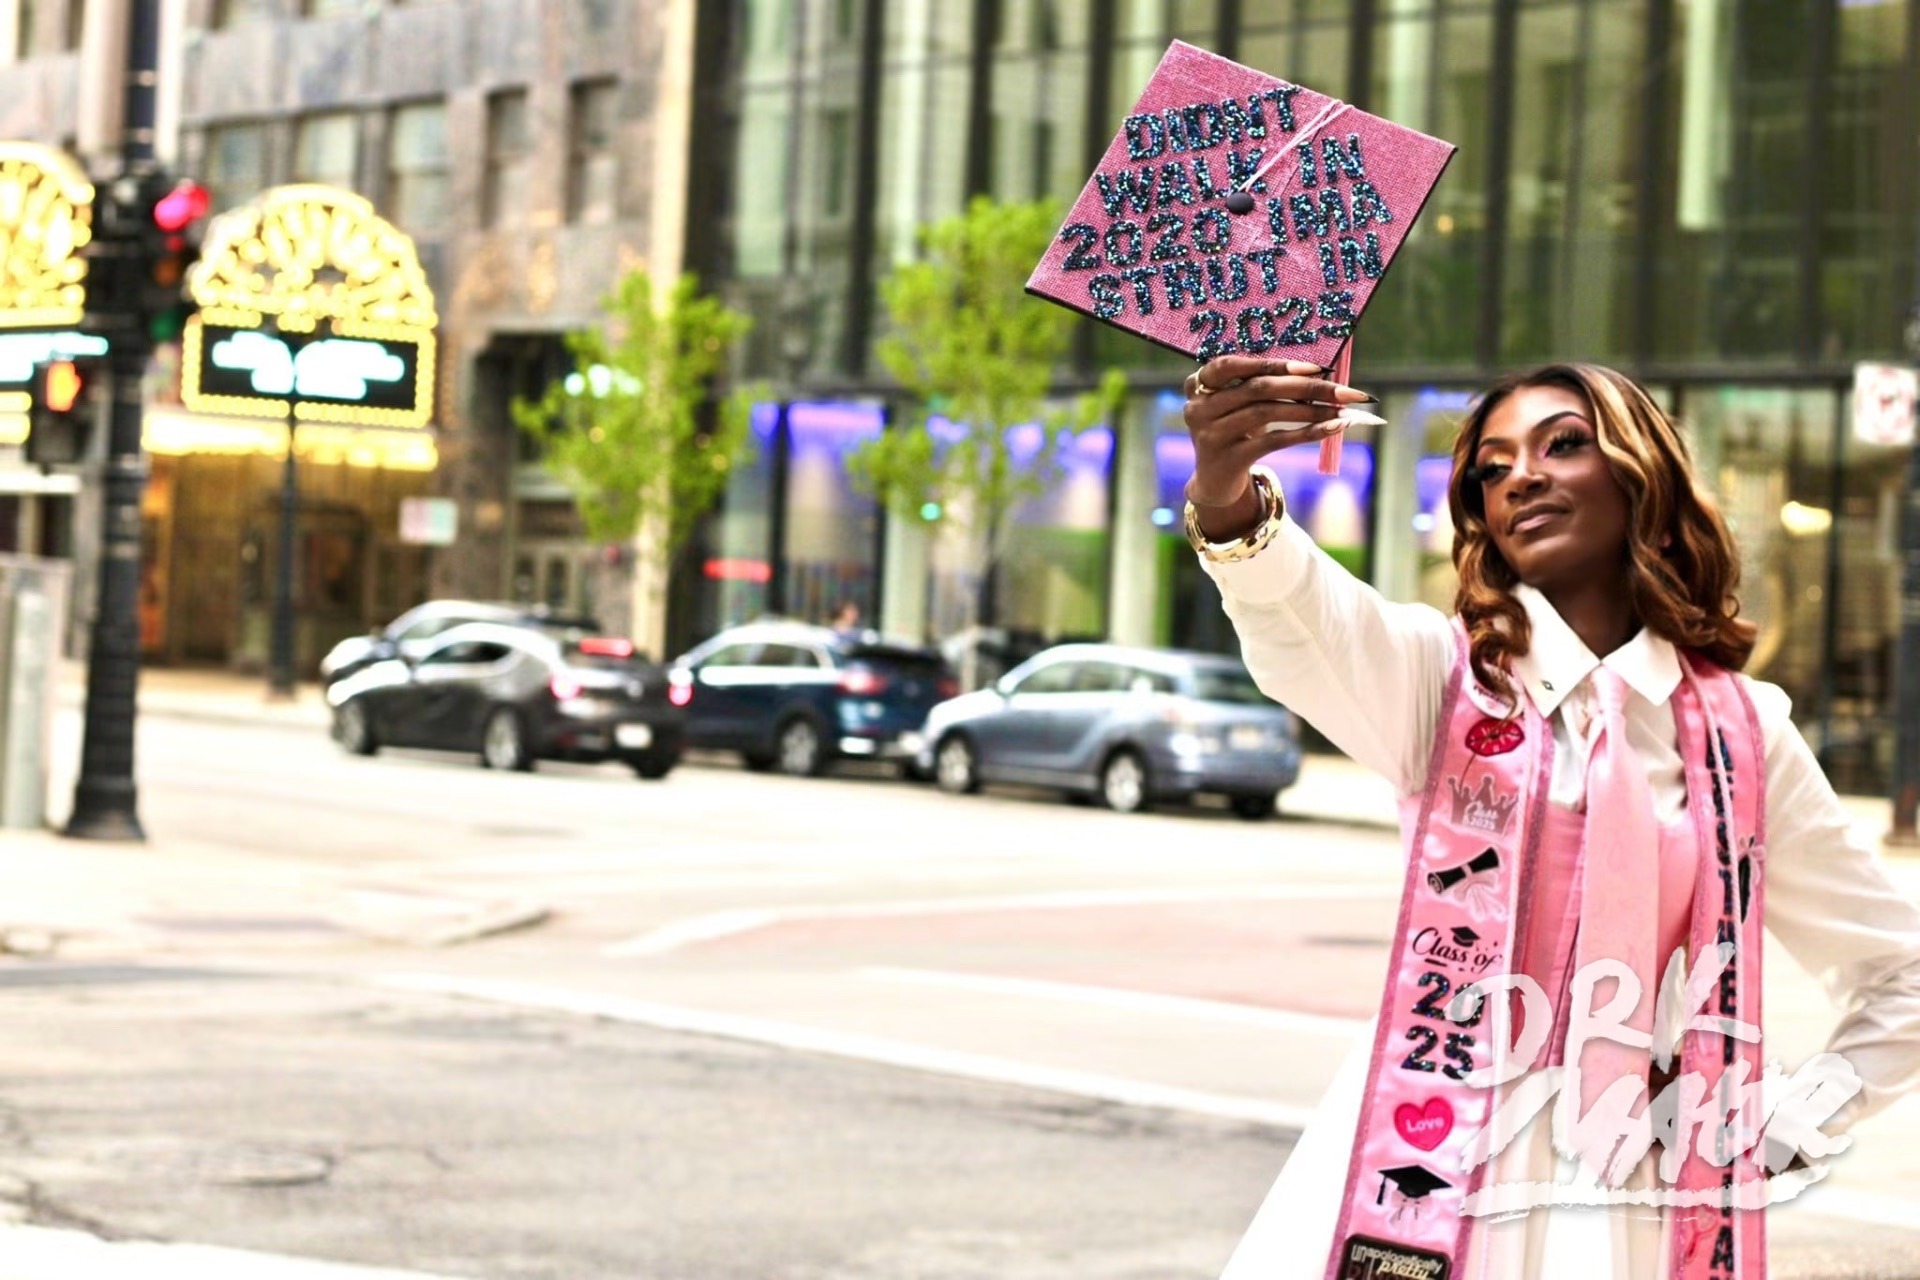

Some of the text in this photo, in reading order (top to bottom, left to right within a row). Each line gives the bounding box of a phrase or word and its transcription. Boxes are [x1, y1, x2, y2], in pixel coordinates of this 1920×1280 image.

[1124, 85, 1300, 160] DIDNT
[1097, 133, 1365, 218] WALK IN
[1060, 181, 1393, 272] 2020 IMA
[1088, 231, 1383, 319] STRUT IN
[1189, 290, 1356, 362] 2025
[1412, 927, 1502, 974] Class of
[1411, 972, 1486, 1028] 20
[1401, 1025, 1477, 1080] 25
[1406, 1117, 1444, 1133] Love
